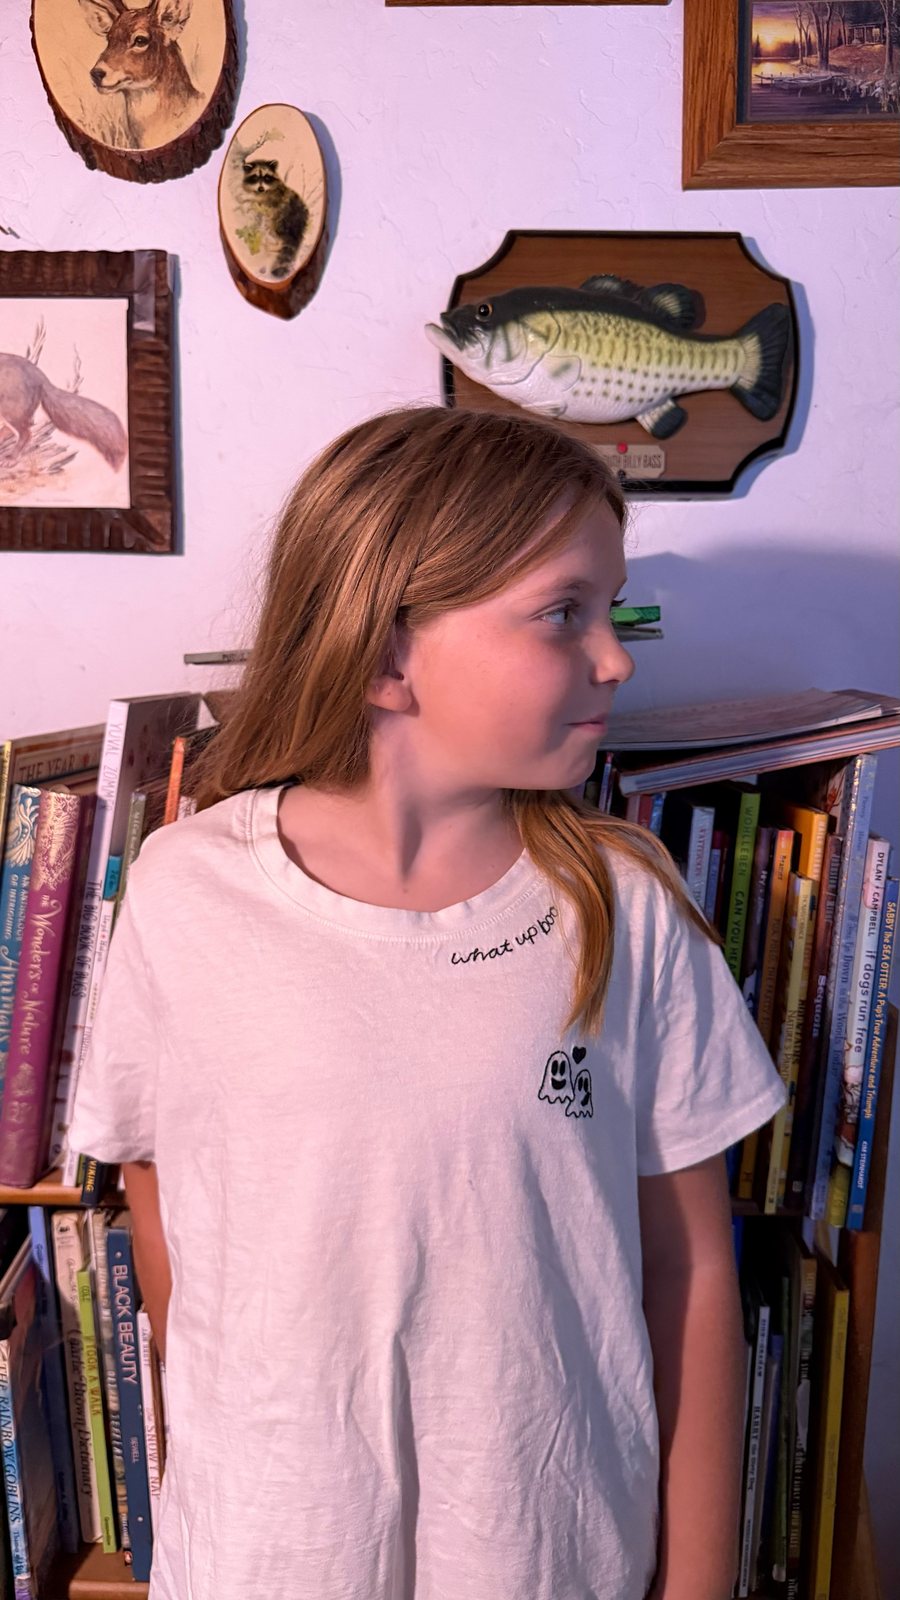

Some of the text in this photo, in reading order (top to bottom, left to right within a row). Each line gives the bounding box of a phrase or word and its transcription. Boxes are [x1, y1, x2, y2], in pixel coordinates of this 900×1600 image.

[623, 454, 641, 469] BILLY
[643, 454, 662, 469] BASS
[104, 722, 123, 757] YUVAL
[19, 760, 44, 785] THE
[48, 752, 76, 777] YEAR
[737, 806, 753, 876] WOHLLEBEN
[874, 851, 885, 881] DYLAN
[4, 887, 17, 940] INTRIGUING
[733, 890, 745, 915] CAN
[867, 891, 881, 937] CAMPBELL
[885, 901, 896, 931] SABBY
[28, 899, 62, 980] Wonders
[71, 880, 103, 998] THE BIG BOOK OF BUGS
[451, 905, 559, 965] what up boo
[731, 919, 741, 944] YOU
[841, 954, 853, 983] Down
[881, 943, 892, 960] SEA
[858, 962, 875, 996] dogs
[17, 990, 47, 1055] Nature
[811, 975, 827, 1037] Sequoia
[857, 1000, 869, 1022] run
[854, 1023, 867, 1053] free
[873, 1018, 884, 1033] True
[870, 1033, 882, 1072] Adventure
[868, 1073, 877, 1088] and
[863, 1089, 876, 1119] Triumph
[84, 1160, 97, 1193] VIKING
[86, 1344, 97, 1370] TOOK
[112, 1264, 140, 1464] BLACK BEAUTY SEWELL
[73, 1373, 88, 1429] Brown
[89, 1385, 102, 1416] WALK
[0, 1396, 15, 1459] RAINBOW
[751, 1405, 761, 1440] HARRY
[76, 1430, 93, 1498] Dictionary
[144, 1424, 159, 1472] SNOWY
[4, 1461, 20, 1524] GOBLINS
